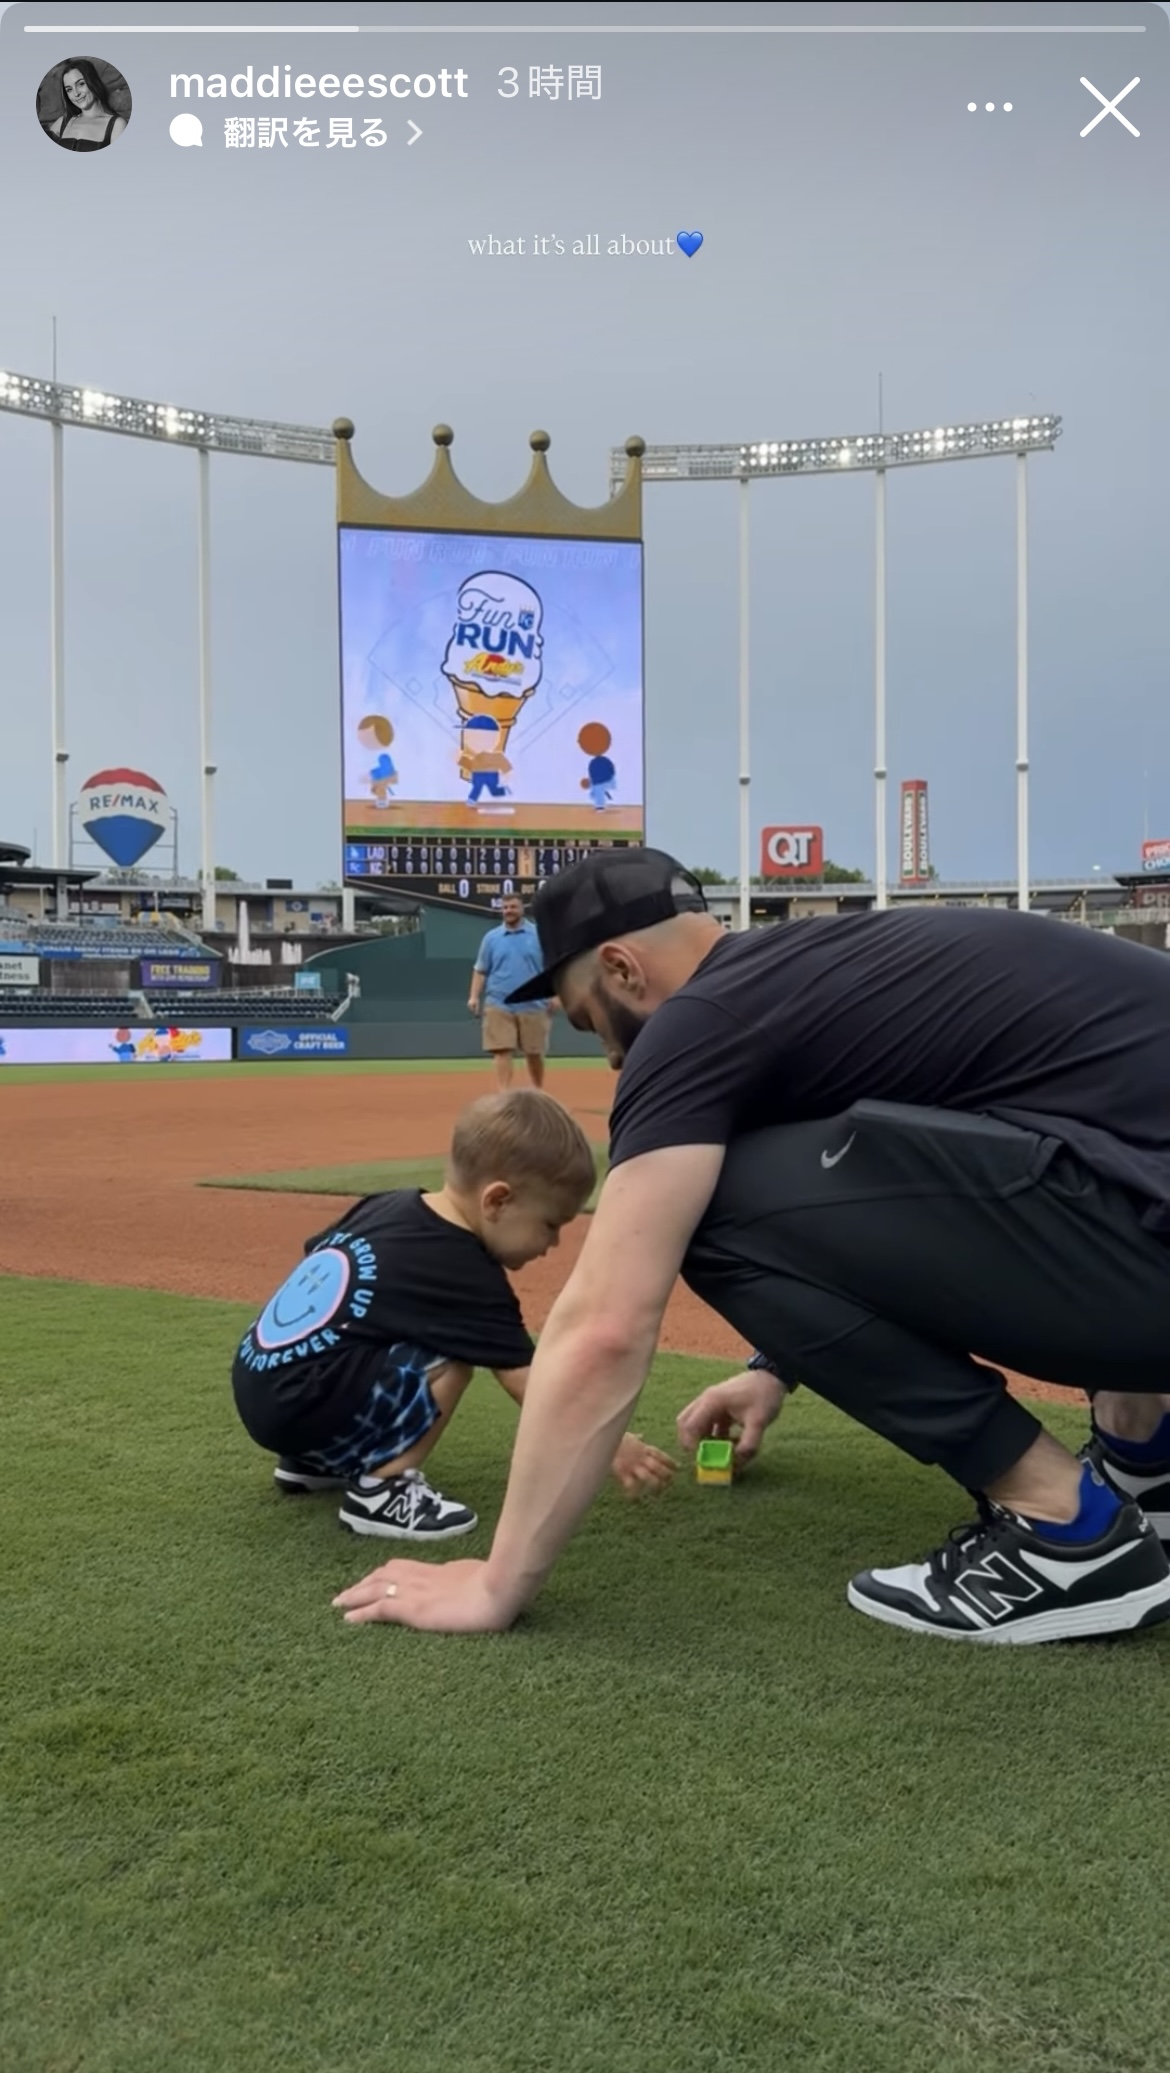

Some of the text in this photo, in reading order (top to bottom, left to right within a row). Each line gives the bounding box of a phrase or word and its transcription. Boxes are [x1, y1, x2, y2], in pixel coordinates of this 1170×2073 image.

[458, 587, 516, 630] Fun
[456, 622, 535, 660] RUN
[90, 793, 159, 814] RE/MAX
[767, 831, 813, 867] QT
[459, 879, 469, 898] 0
[293, 1041, 321, 1050] CRAFT
[323, 1041, 345, 1050] BEER
[298, 1033, 337, 1042] OFFICIAL
[349, 1237, 378, 1318] GROW UP
[955, 1551, 1045, 1620] N
